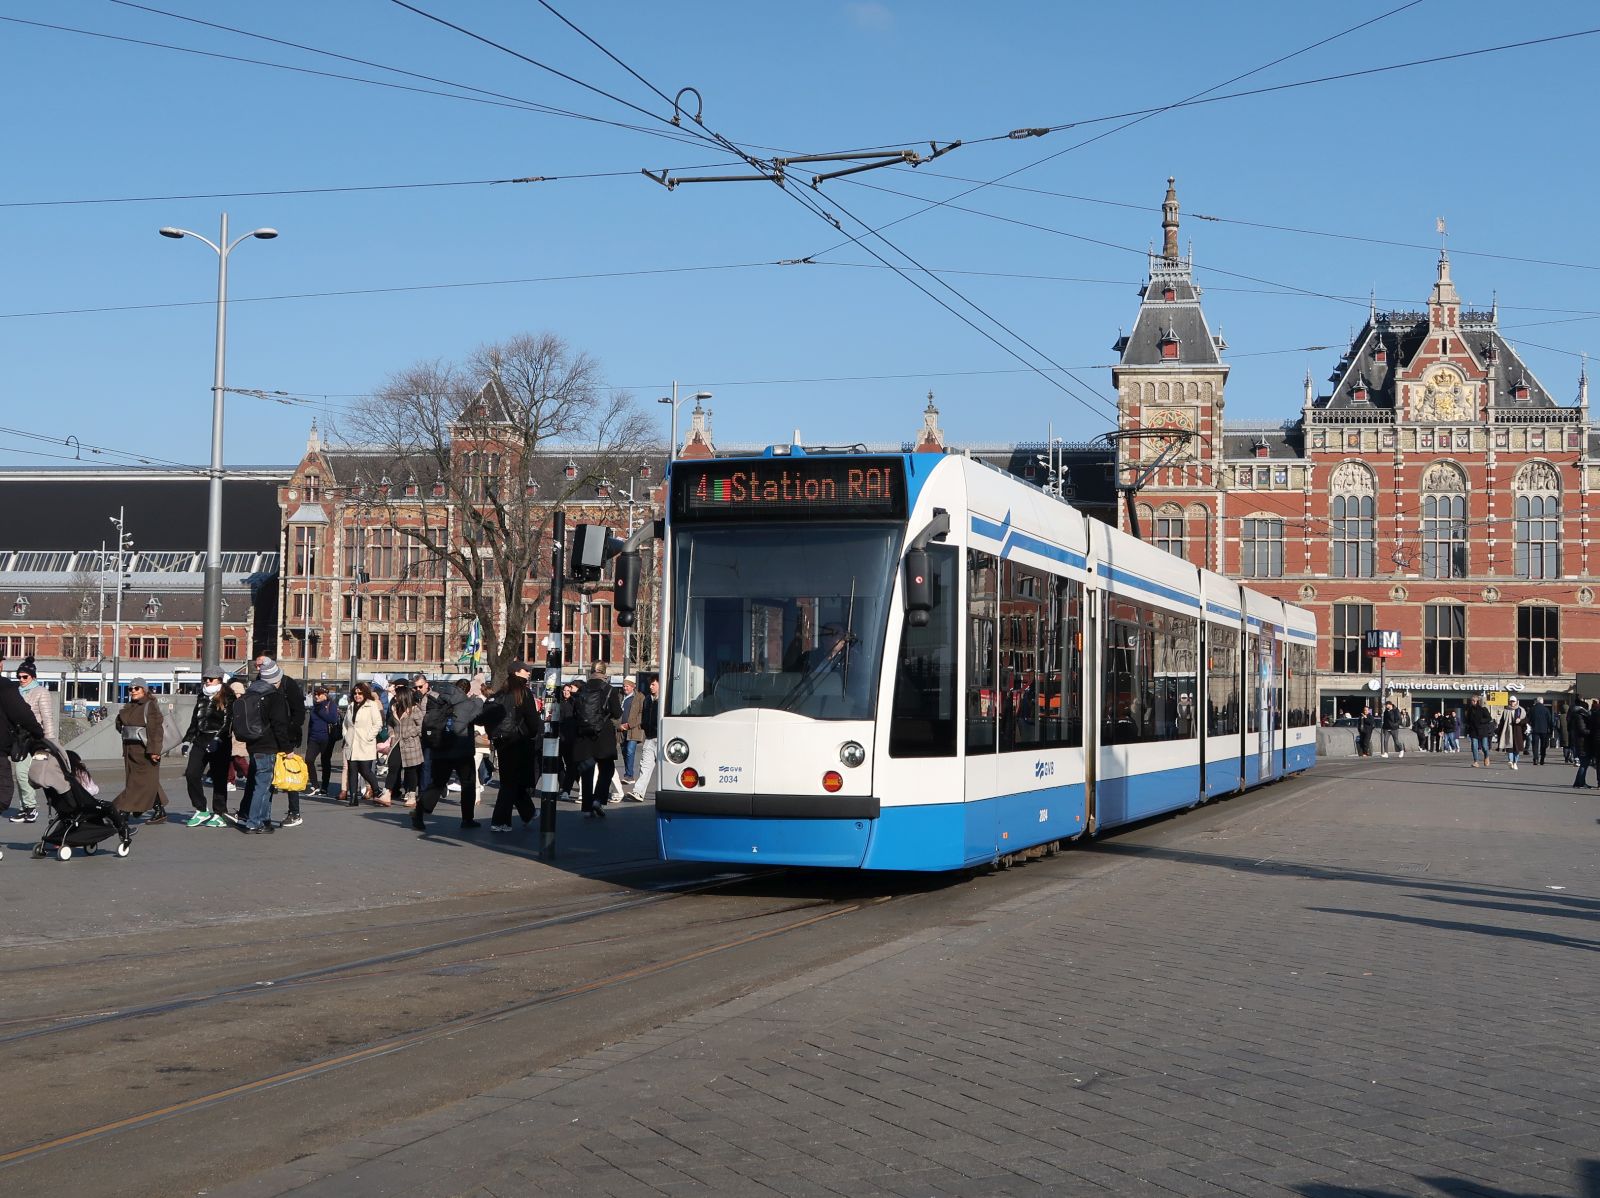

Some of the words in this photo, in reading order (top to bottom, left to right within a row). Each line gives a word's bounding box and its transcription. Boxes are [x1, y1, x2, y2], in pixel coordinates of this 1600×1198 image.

[696, 473, 707, 501] 4
[731, 471, 836, 501] Station
[848, 468, 891, 499] RAI
[1367, 631, 1377, 648] M
[1383, 631, 1398, 648] M
[1387, 681, 1449, 690] Amsterdam
[1452, 682, 1499, 691] Centraal
[719, 775, 738, 783] 2034
